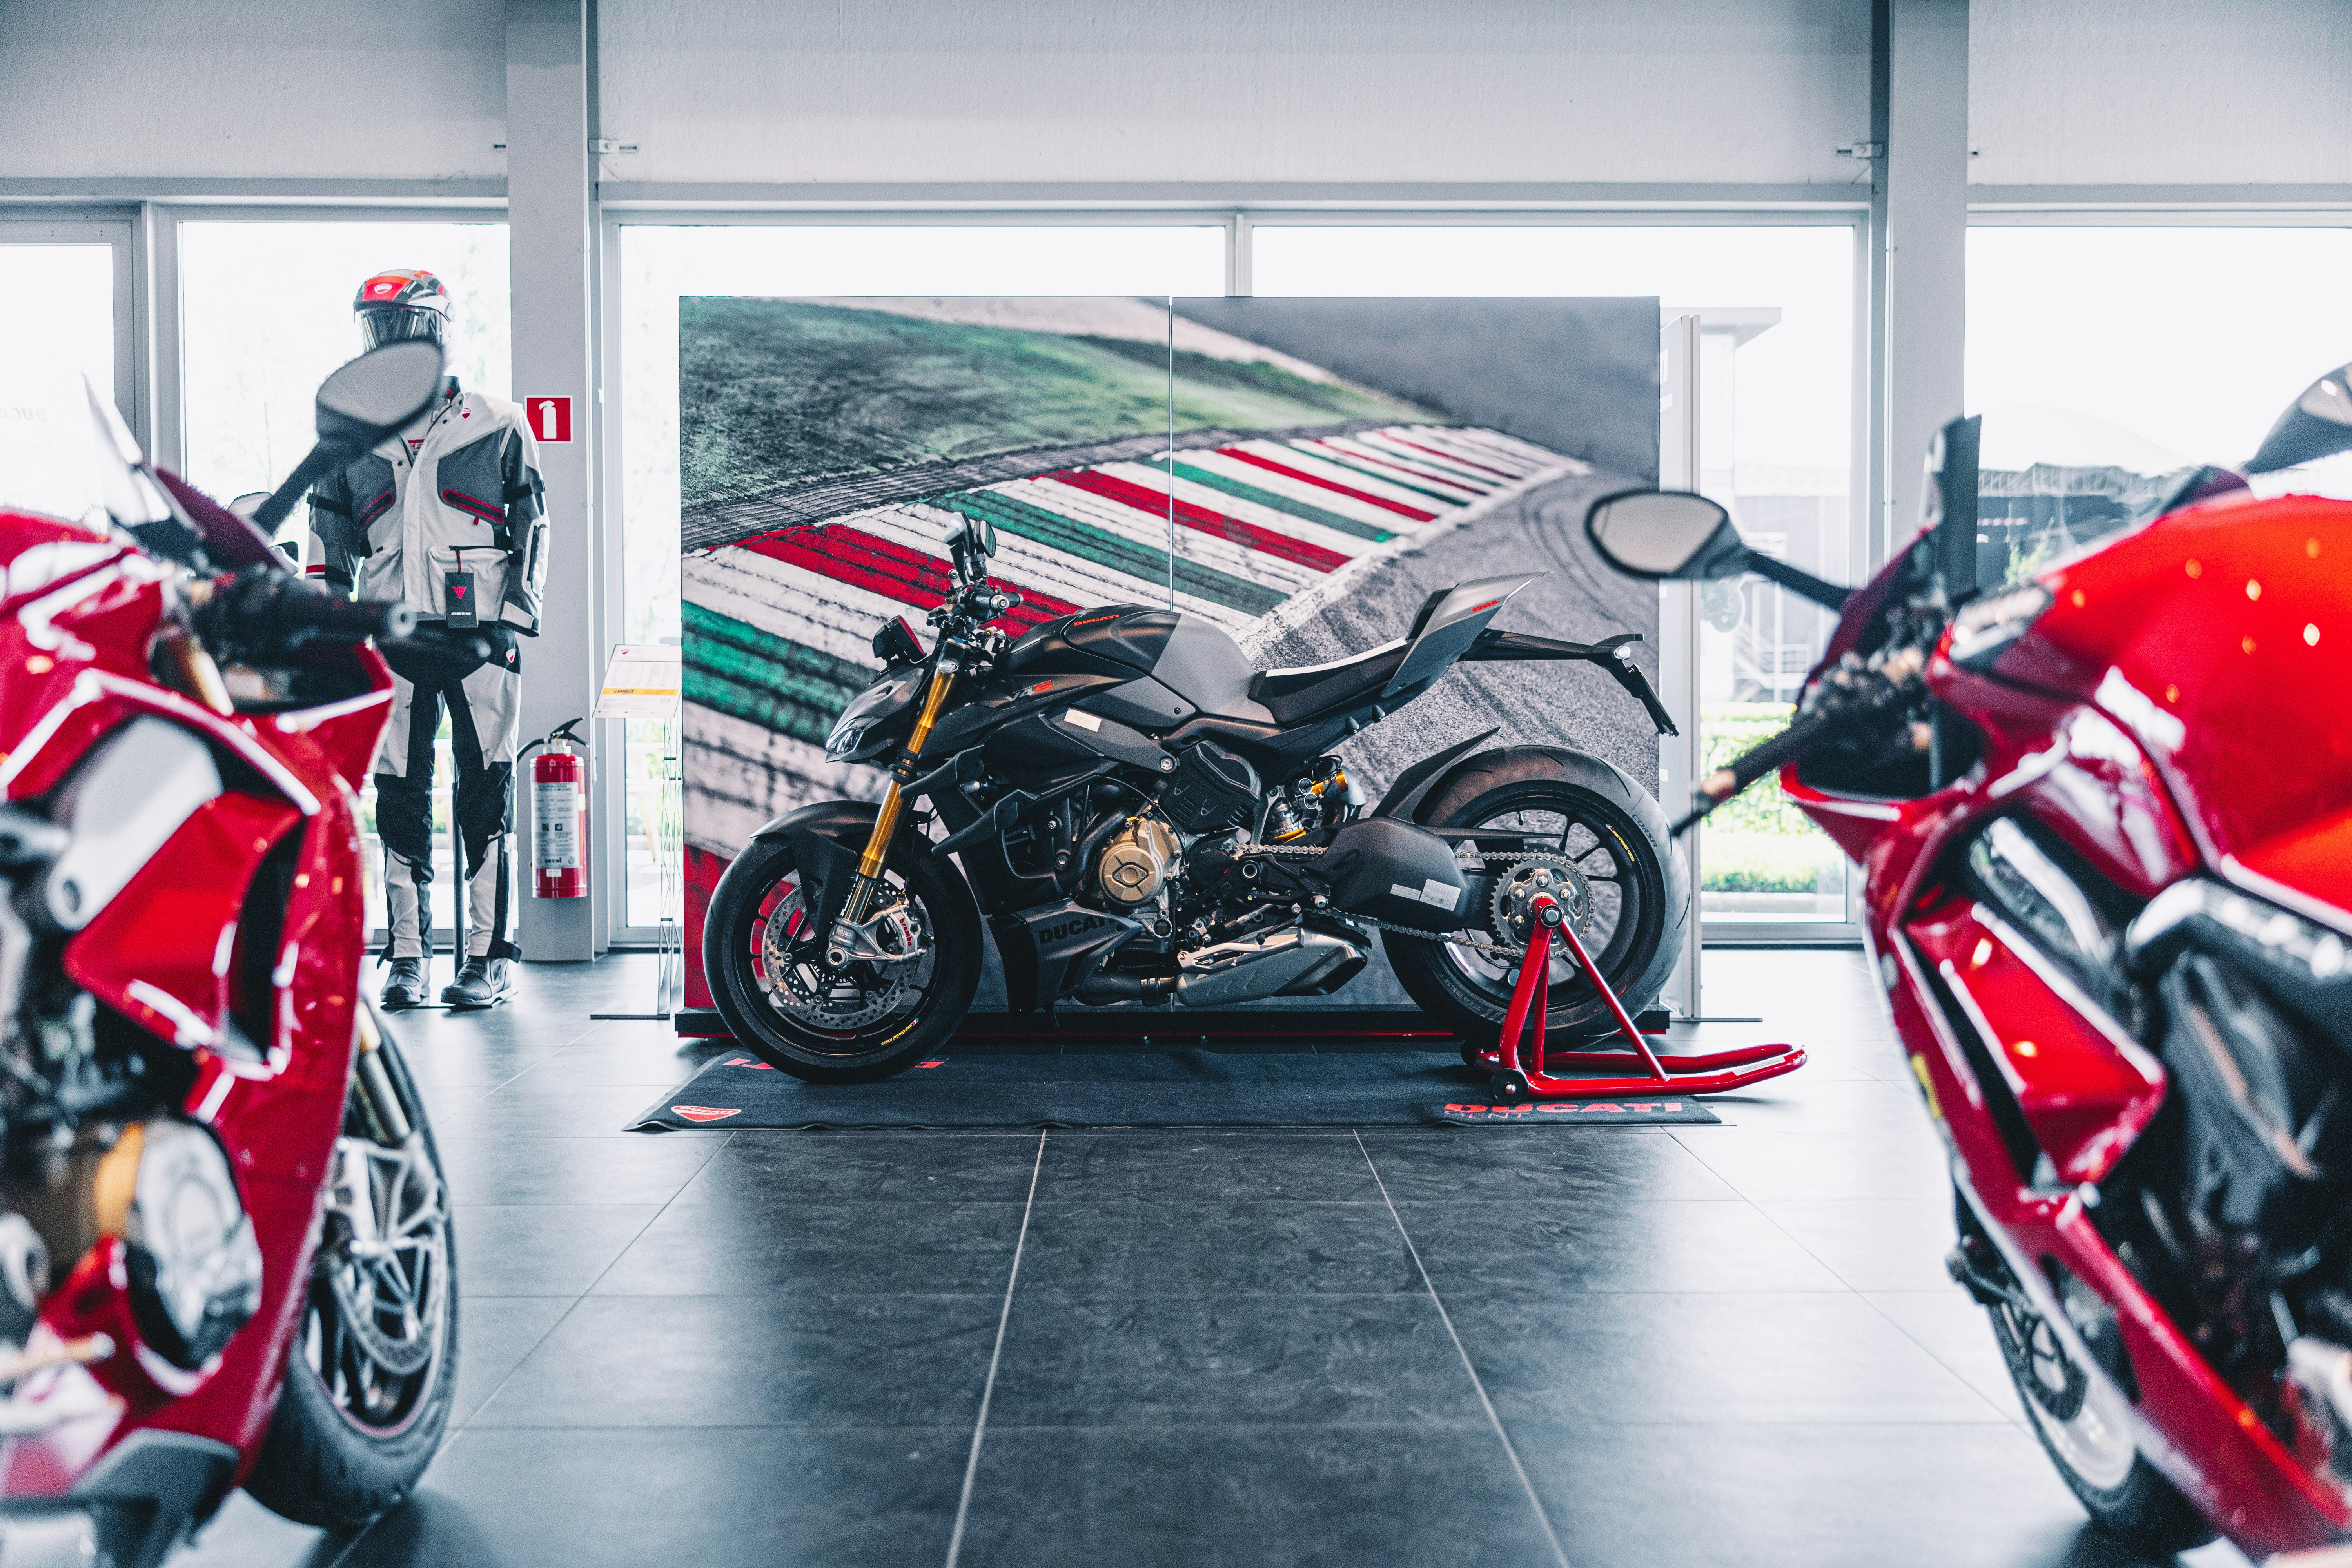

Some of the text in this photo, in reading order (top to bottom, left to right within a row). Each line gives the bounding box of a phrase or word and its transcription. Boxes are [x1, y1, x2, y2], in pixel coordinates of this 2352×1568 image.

[1074, 615, 1120, 626] DUCATI
[1612, 830, 1629, 850] marchesini
[1632, 814, 1657, 847] CORSA
[899, 918, 913, 946] brembo
[1444, 979, 1481, 1011] DIABLO
[892, 1024, 912, 1040] marchesini
[1444, 1103, 1682, 1113] DUCATI
